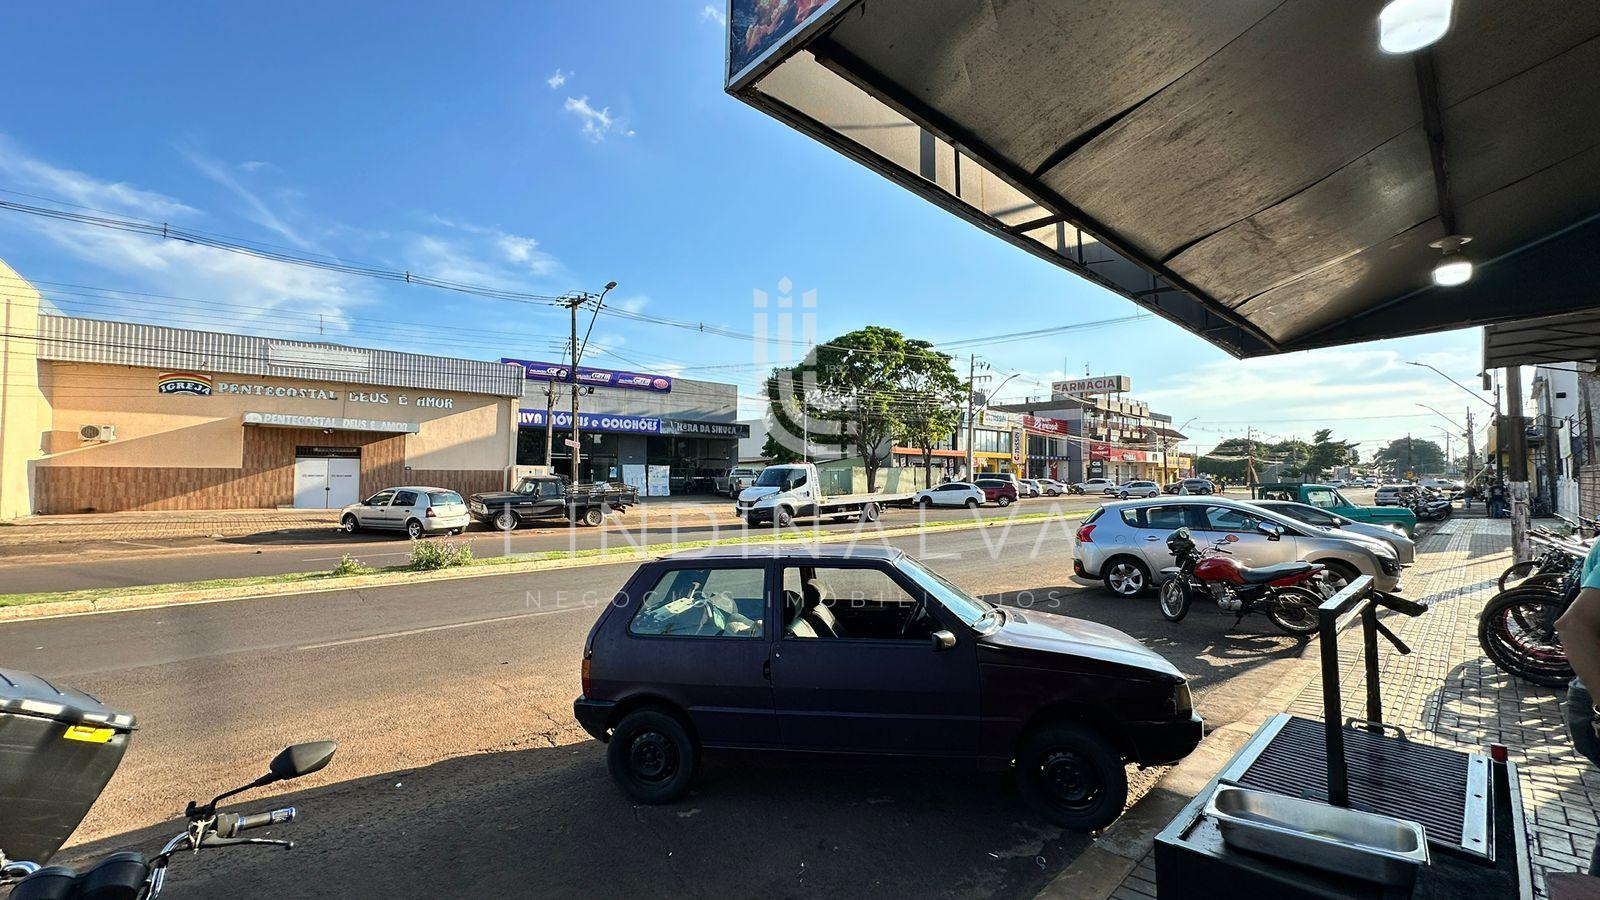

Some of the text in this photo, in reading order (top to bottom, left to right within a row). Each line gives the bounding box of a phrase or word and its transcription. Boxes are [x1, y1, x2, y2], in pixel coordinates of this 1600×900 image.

[160, 381, 211, 395] IGREJA
[217, 382, 338, 400] PENTECOSTAL
[349, 391, 389, 404] DEUS
[416, 396, 453, 409] AMOR
[264, 413, 337, 427] PENTECOSTAL
[342, 418, 367, 429] DEUS
[381, 421, 408, 432] AMOR
[601, 417, 658, 431] COLCHÕES
